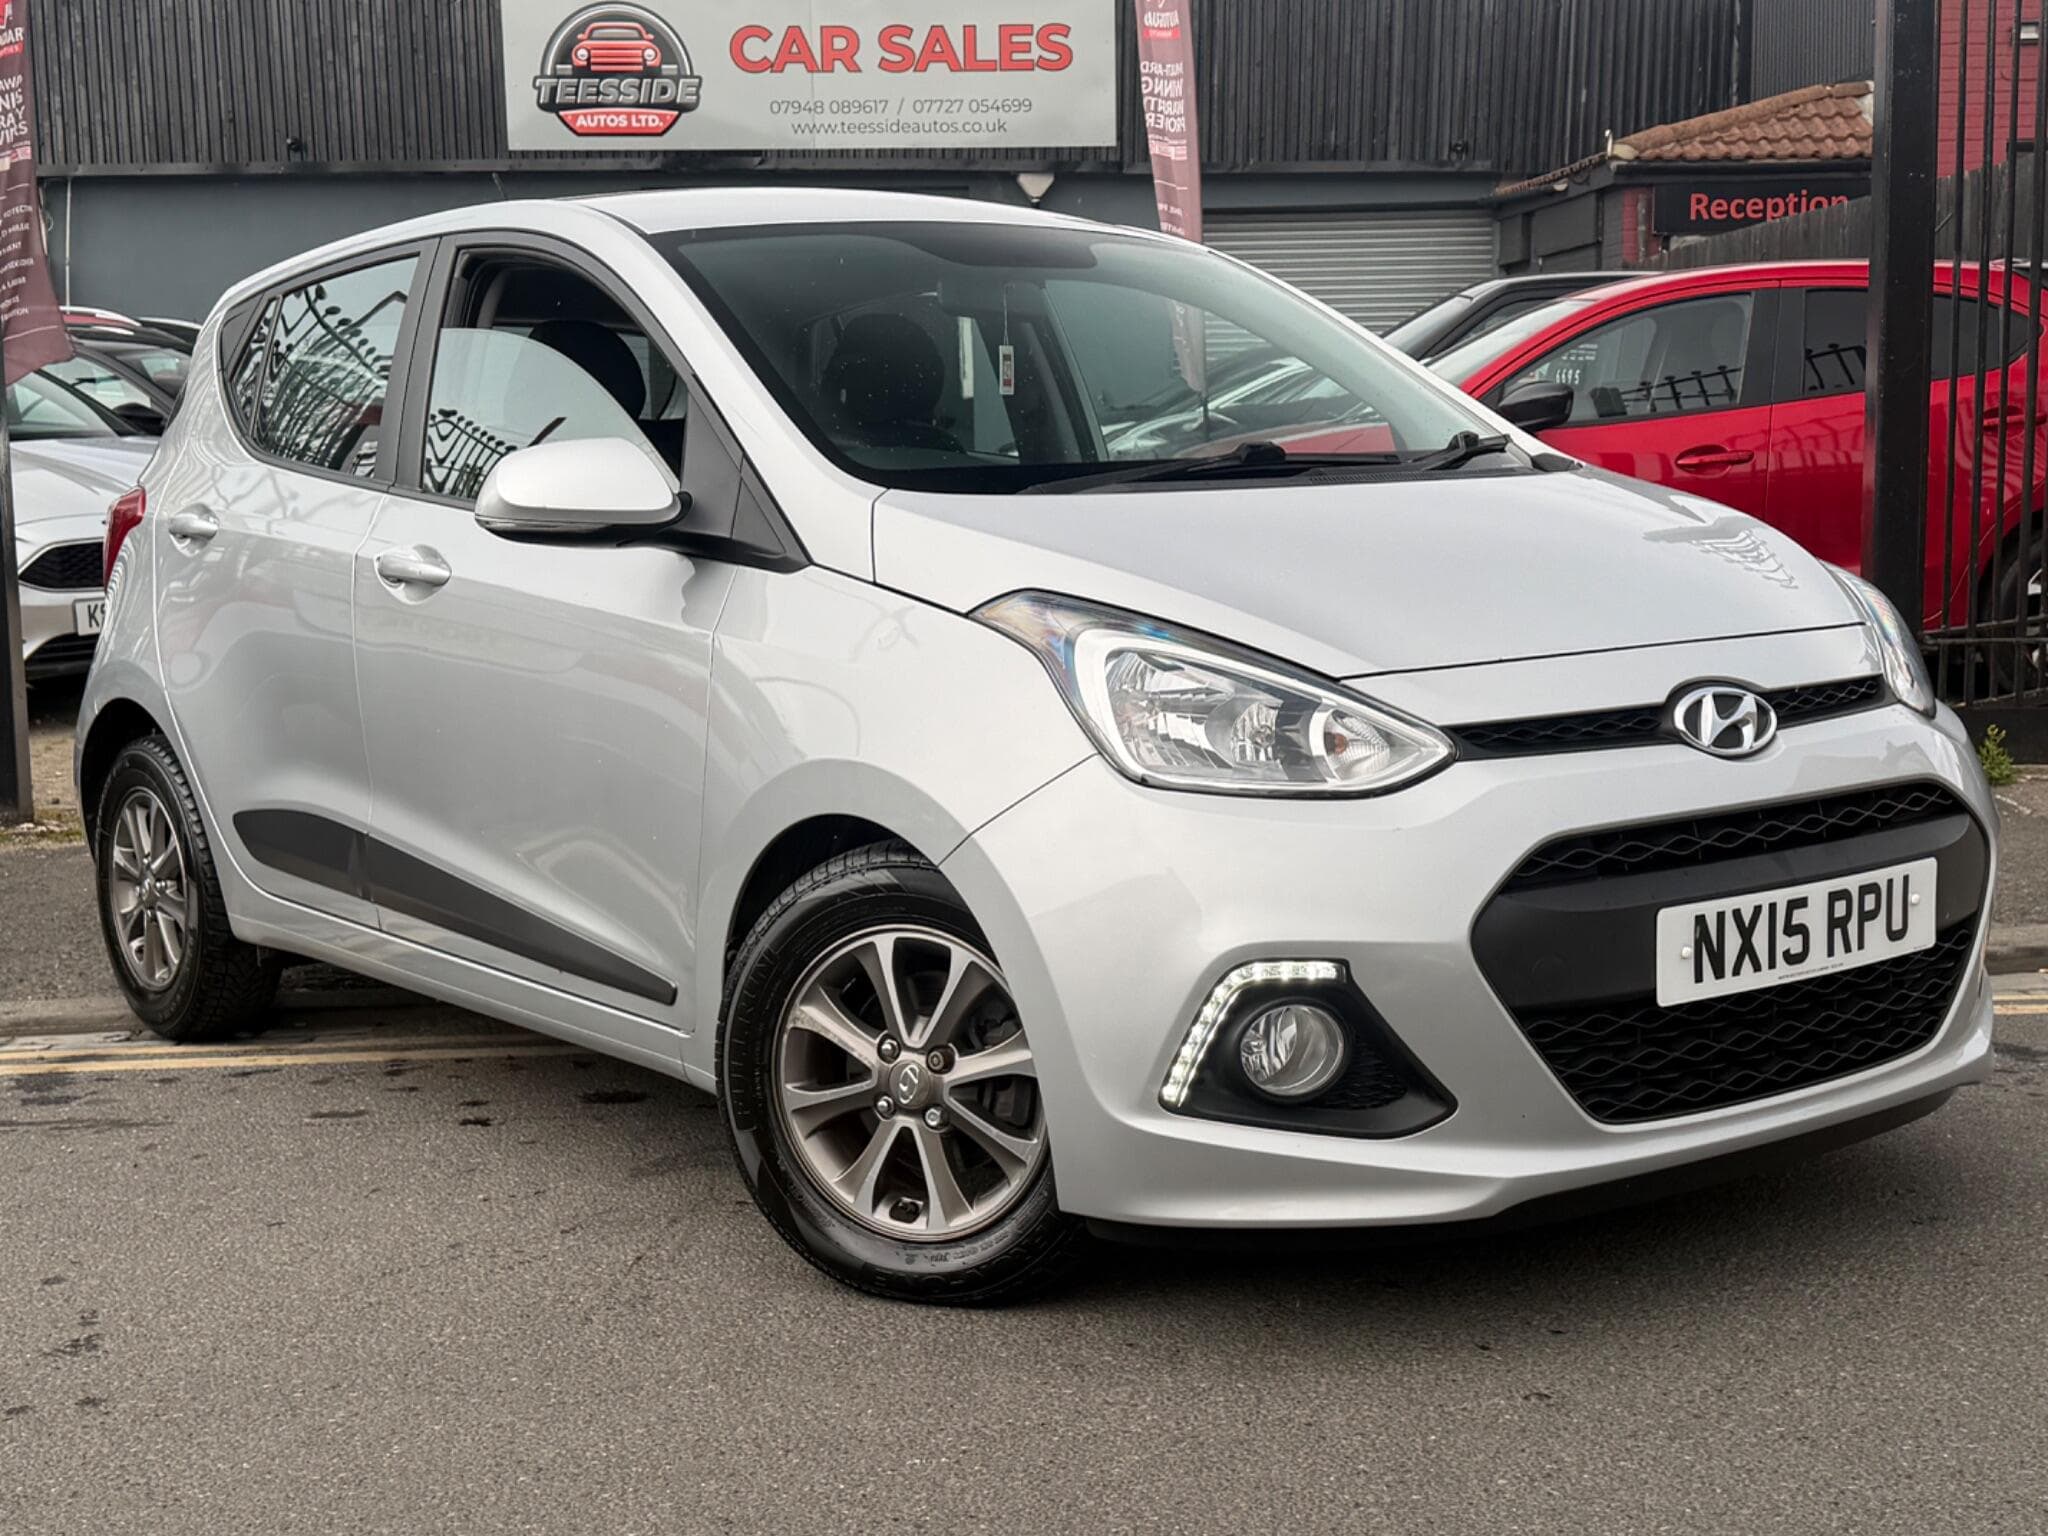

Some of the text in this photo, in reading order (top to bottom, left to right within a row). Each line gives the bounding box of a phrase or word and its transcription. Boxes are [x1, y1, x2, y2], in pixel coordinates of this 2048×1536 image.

[729, 23, 1074, 73] CAR SALES
[535, 78, 700, 104] TEESSIDE
[769, 99, 825, 115] 07948
[829, 99, 889, 115] 089617
[912, 98, 964, 114] 07727
[968, 97, 1033, 114] 054699
[576, 114, 664, 128] AUTOS LTD.
[791, 118, 1008, 135] www.teessideautos.co.uk
[1694, 873, 1910, 985] NX15 RPU
